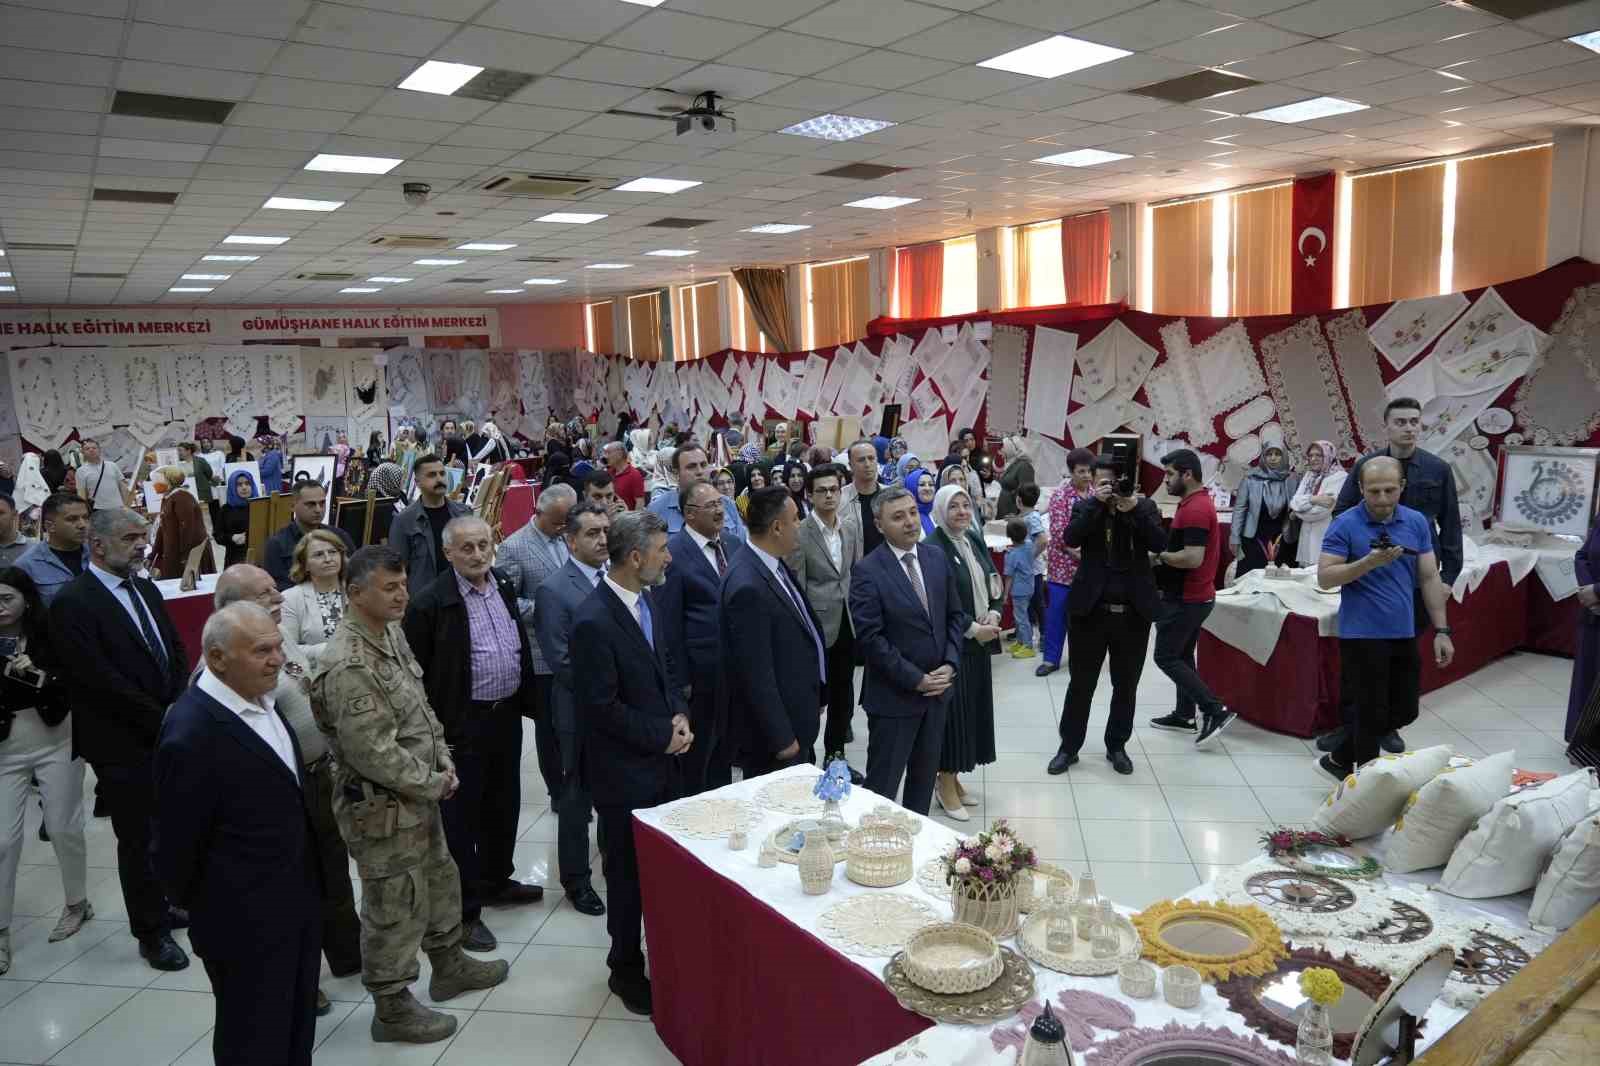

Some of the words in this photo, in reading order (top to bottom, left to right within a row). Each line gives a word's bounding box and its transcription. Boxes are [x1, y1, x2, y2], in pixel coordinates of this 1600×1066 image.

[0, 322, 14, 334] E
[18, 322, 67, 334] HALK
[73, 318, 134, 334] EĞİTİM
[138, 318, 211, 334] MERKEZİ
[242, 316, 341, 333] GÜMÜŞHANE
[343, 317, 380, 329] HALK
[383, 314, 430, 329] EĞİTİM
[431, 315, 487, 328] MERKEZİ
